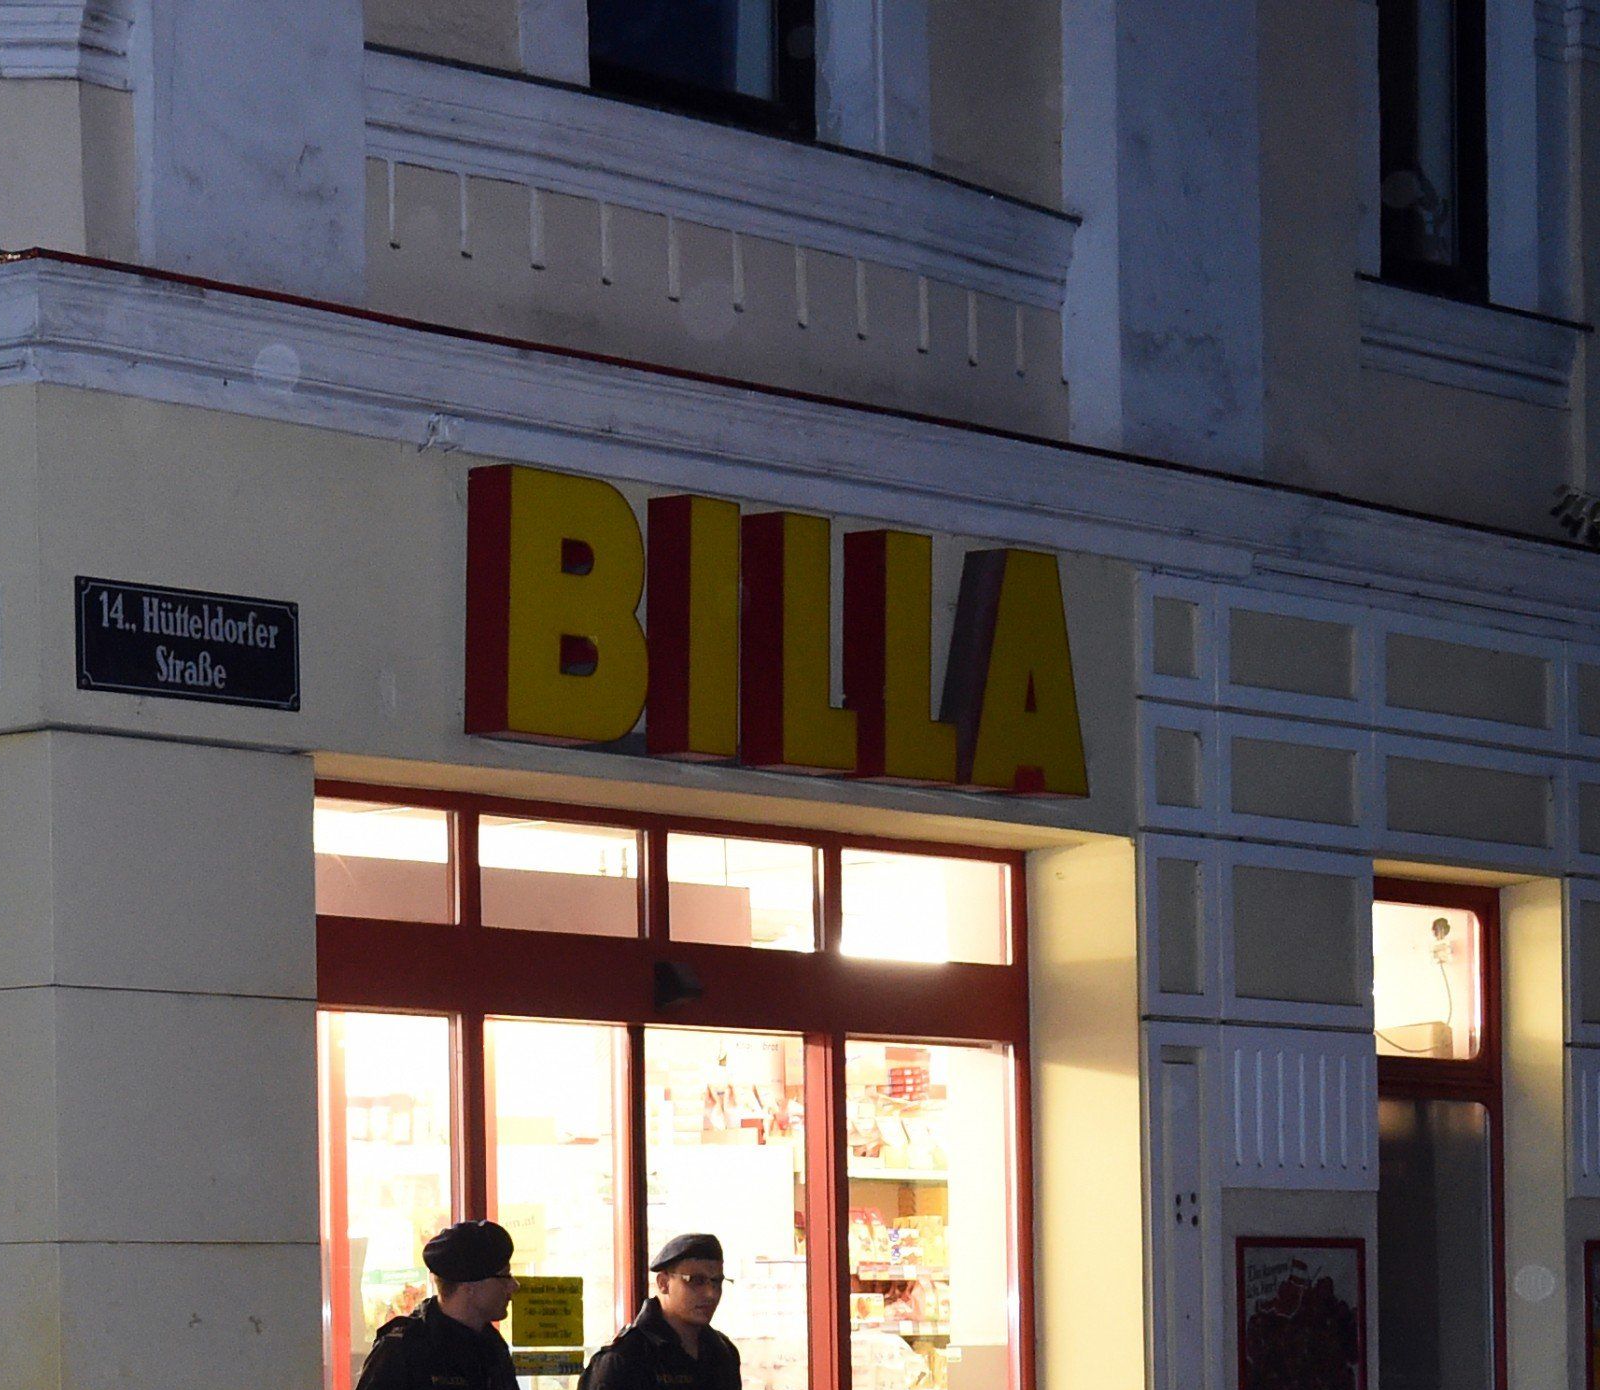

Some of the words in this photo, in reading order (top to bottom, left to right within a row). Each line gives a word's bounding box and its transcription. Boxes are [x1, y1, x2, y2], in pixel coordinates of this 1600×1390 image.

[142, 596, 279, 649] Hütteldorfer
[463, 464, 1090, 798] BILLA
[155, 644, 227, 690] Straße
